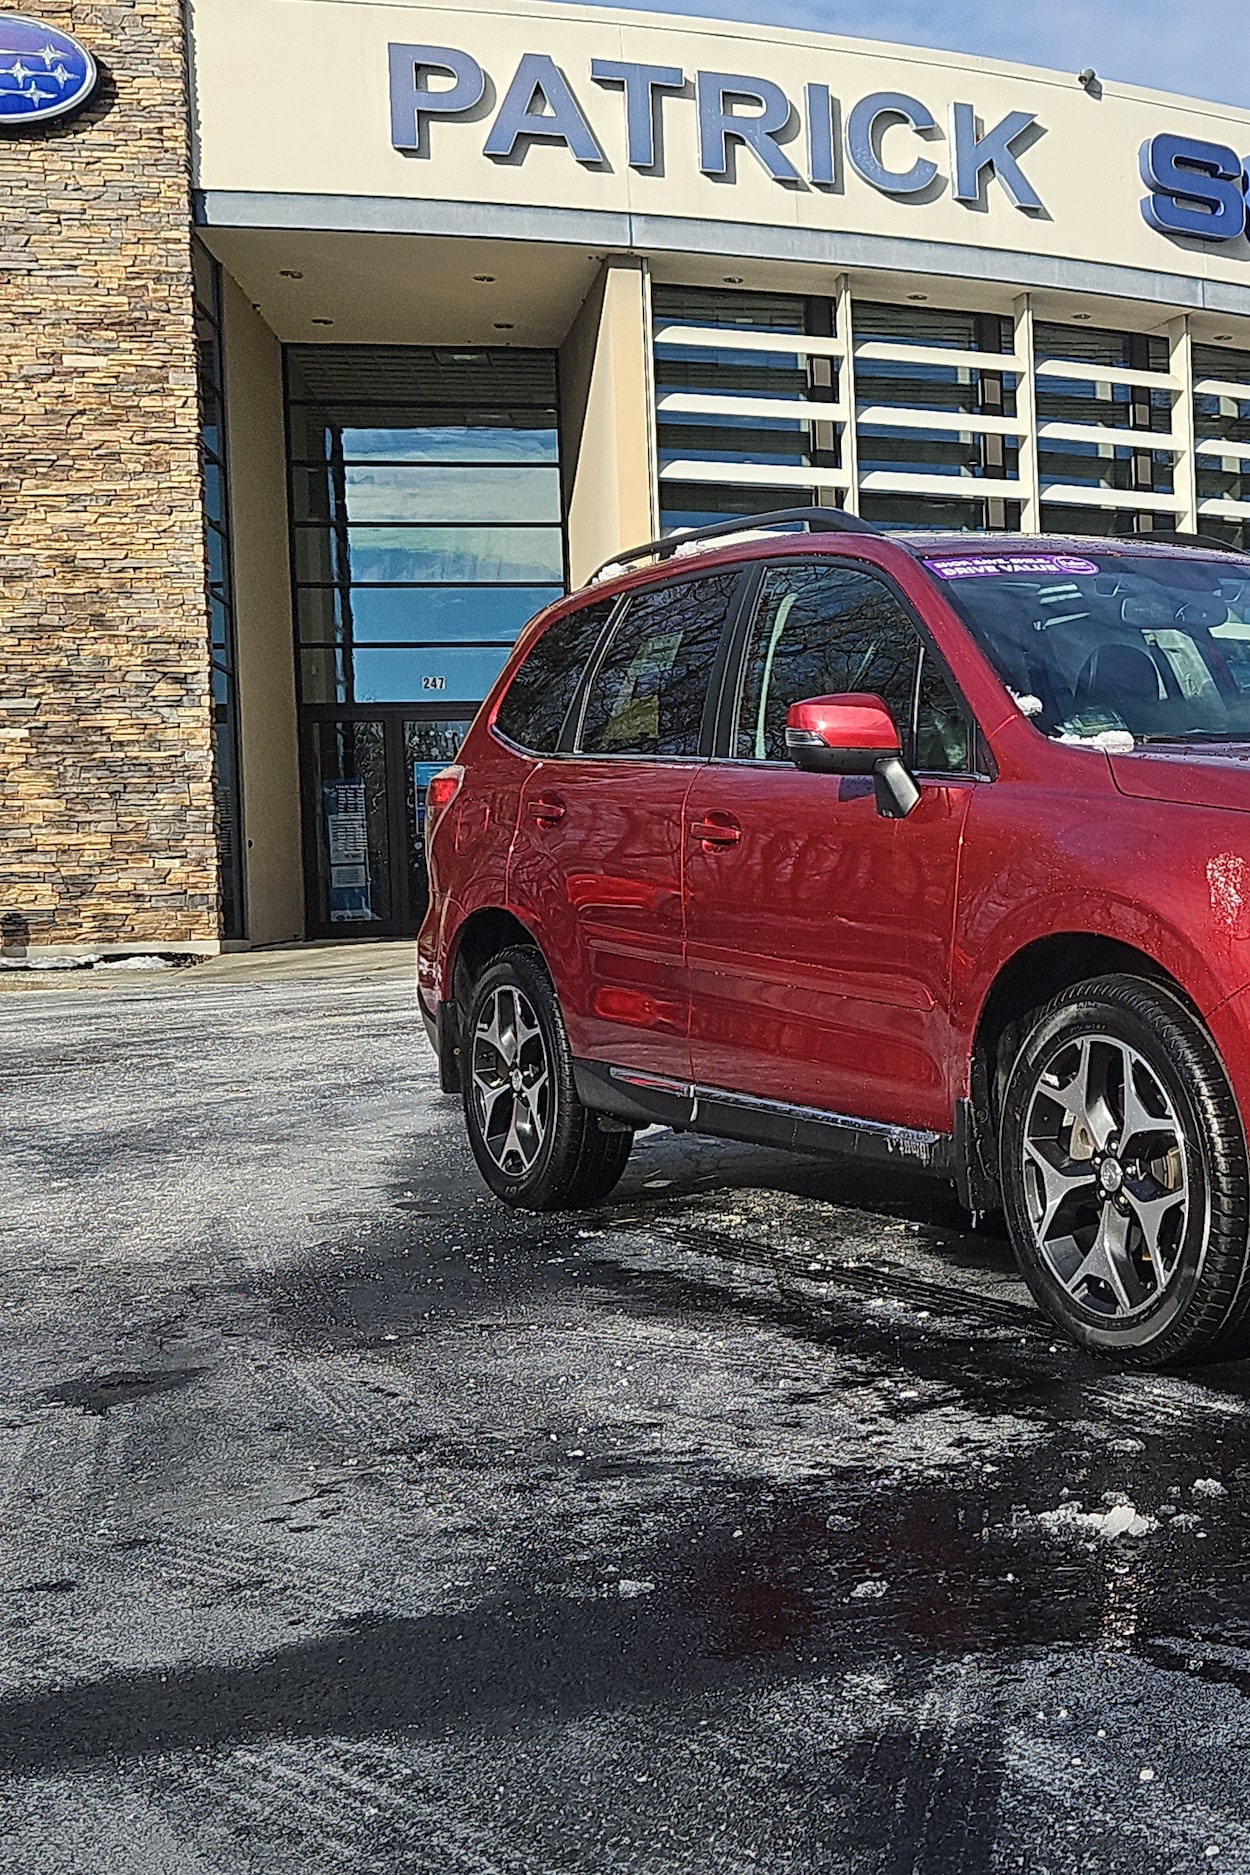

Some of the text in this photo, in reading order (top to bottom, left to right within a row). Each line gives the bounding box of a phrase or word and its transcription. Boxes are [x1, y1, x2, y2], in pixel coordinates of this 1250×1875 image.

[387, 42, 1043, 211] PATRICK
[942, 566, 1000, 575] DRIVE
[999, 563, 1061, 572] VALUE
[422, 677, 445, 690] 247
